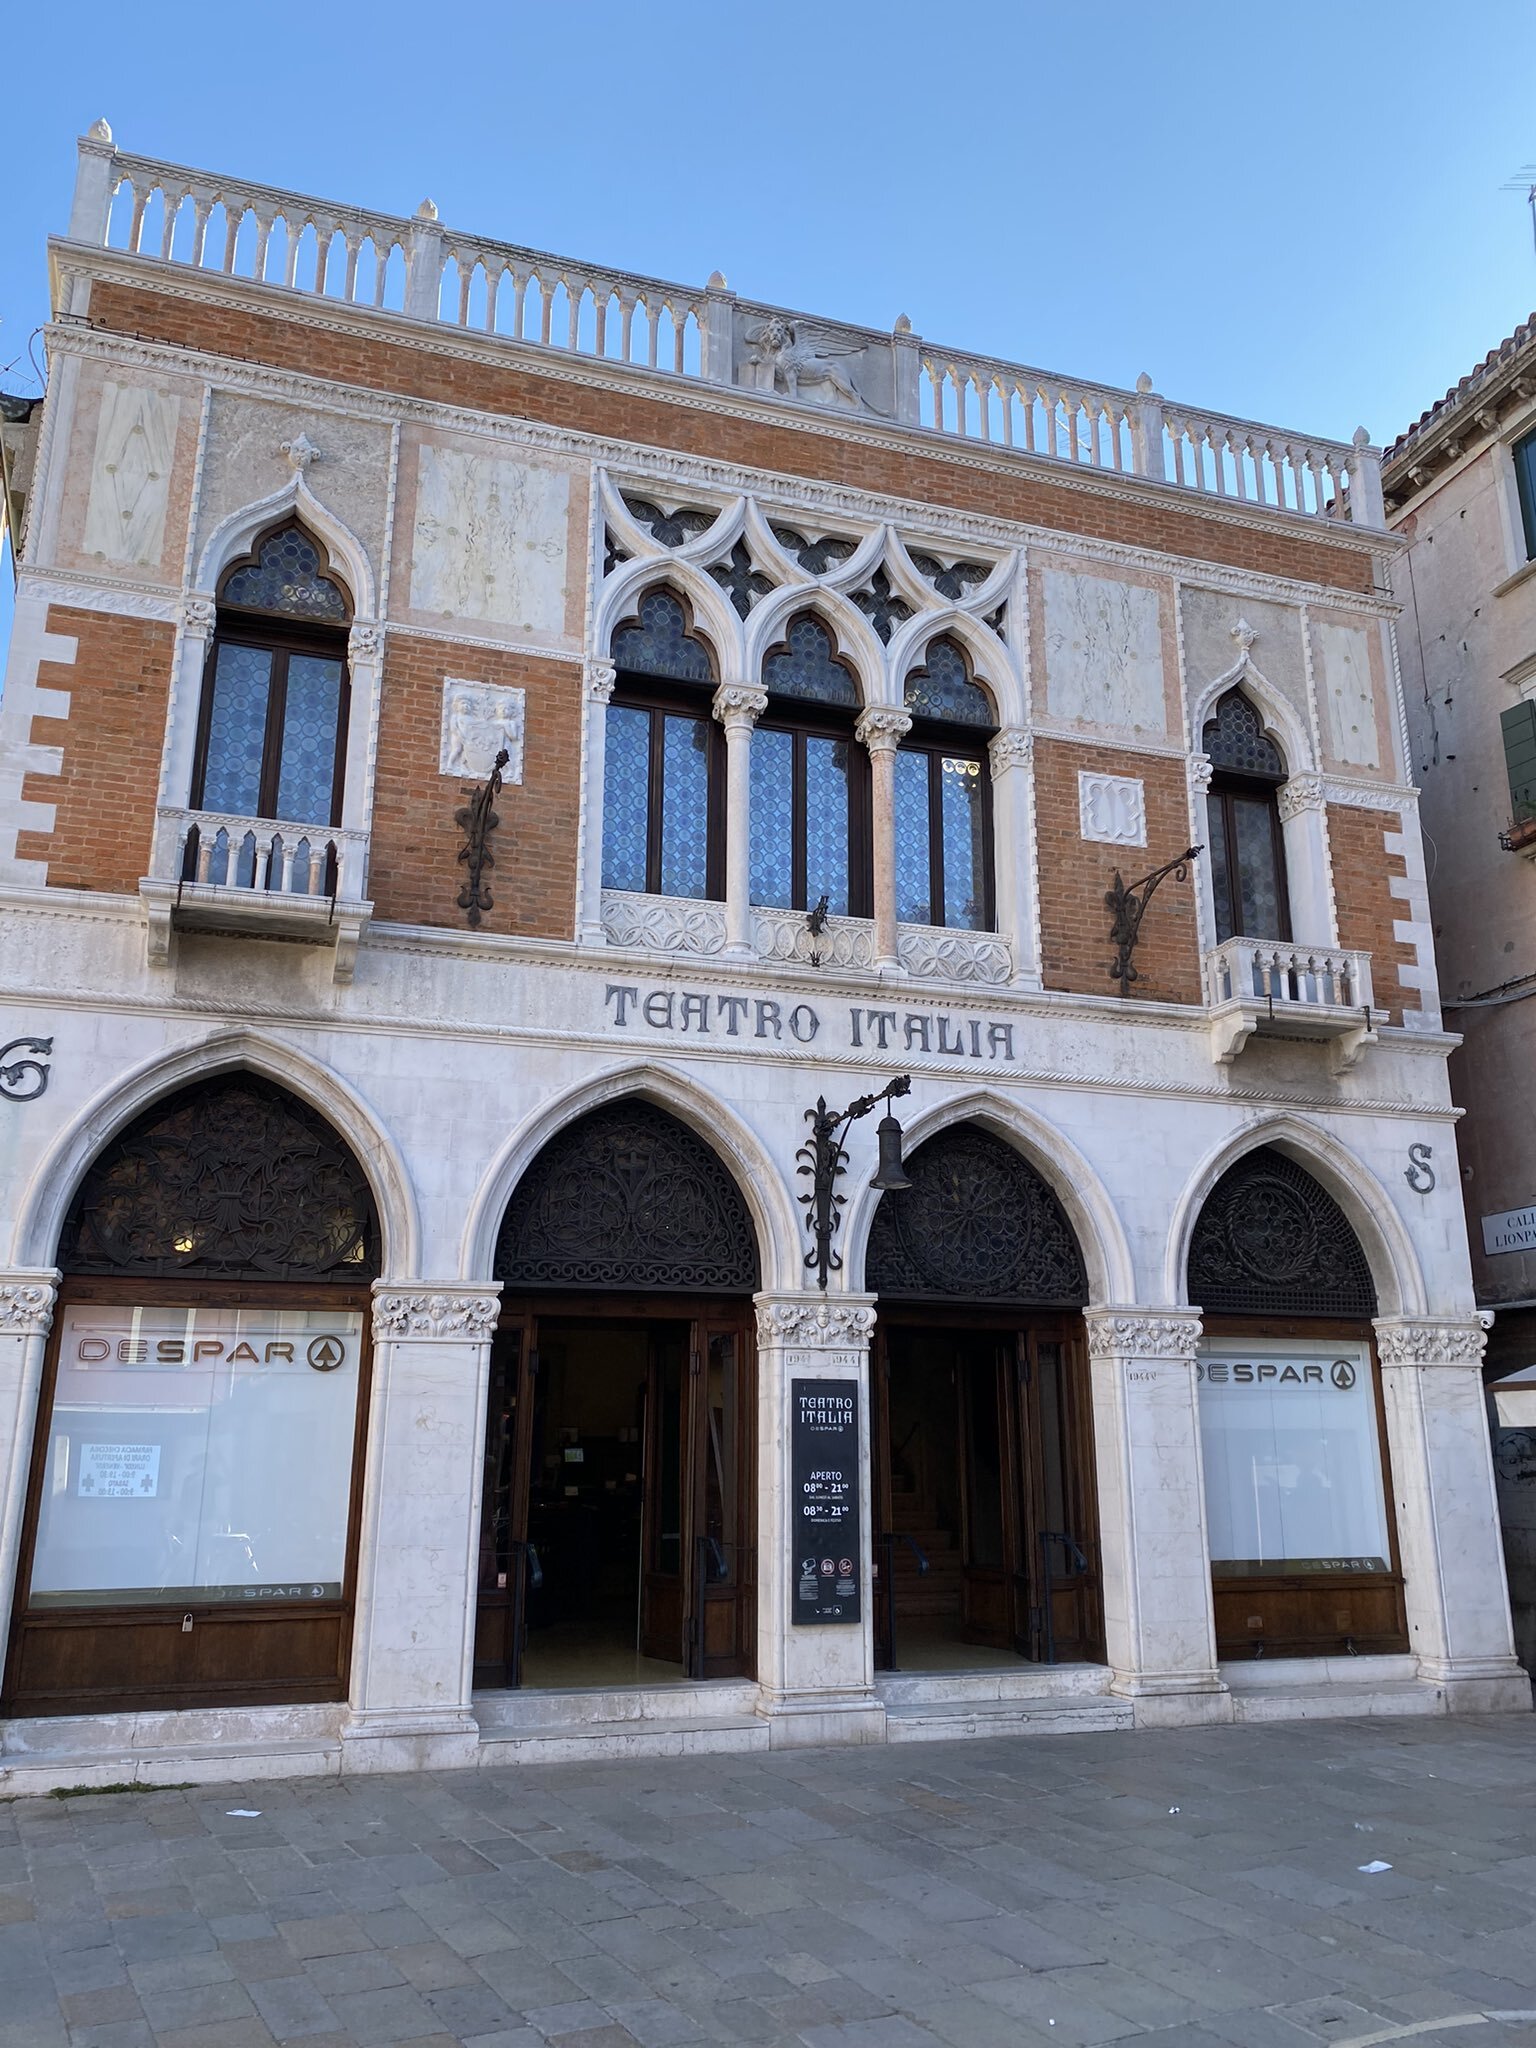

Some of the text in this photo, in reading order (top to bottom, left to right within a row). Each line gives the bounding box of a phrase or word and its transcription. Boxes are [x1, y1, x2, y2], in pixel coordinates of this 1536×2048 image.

[604, 983, 1014, 1061] TEATRO ITALIA
[78, 1338, 295, 1364] DESPAR
[799, 1397, 853, 1409] TEATRO
[801, 1411, 853, 1424] ITALIA
[810, 1471, 842, 1481] APERTO
